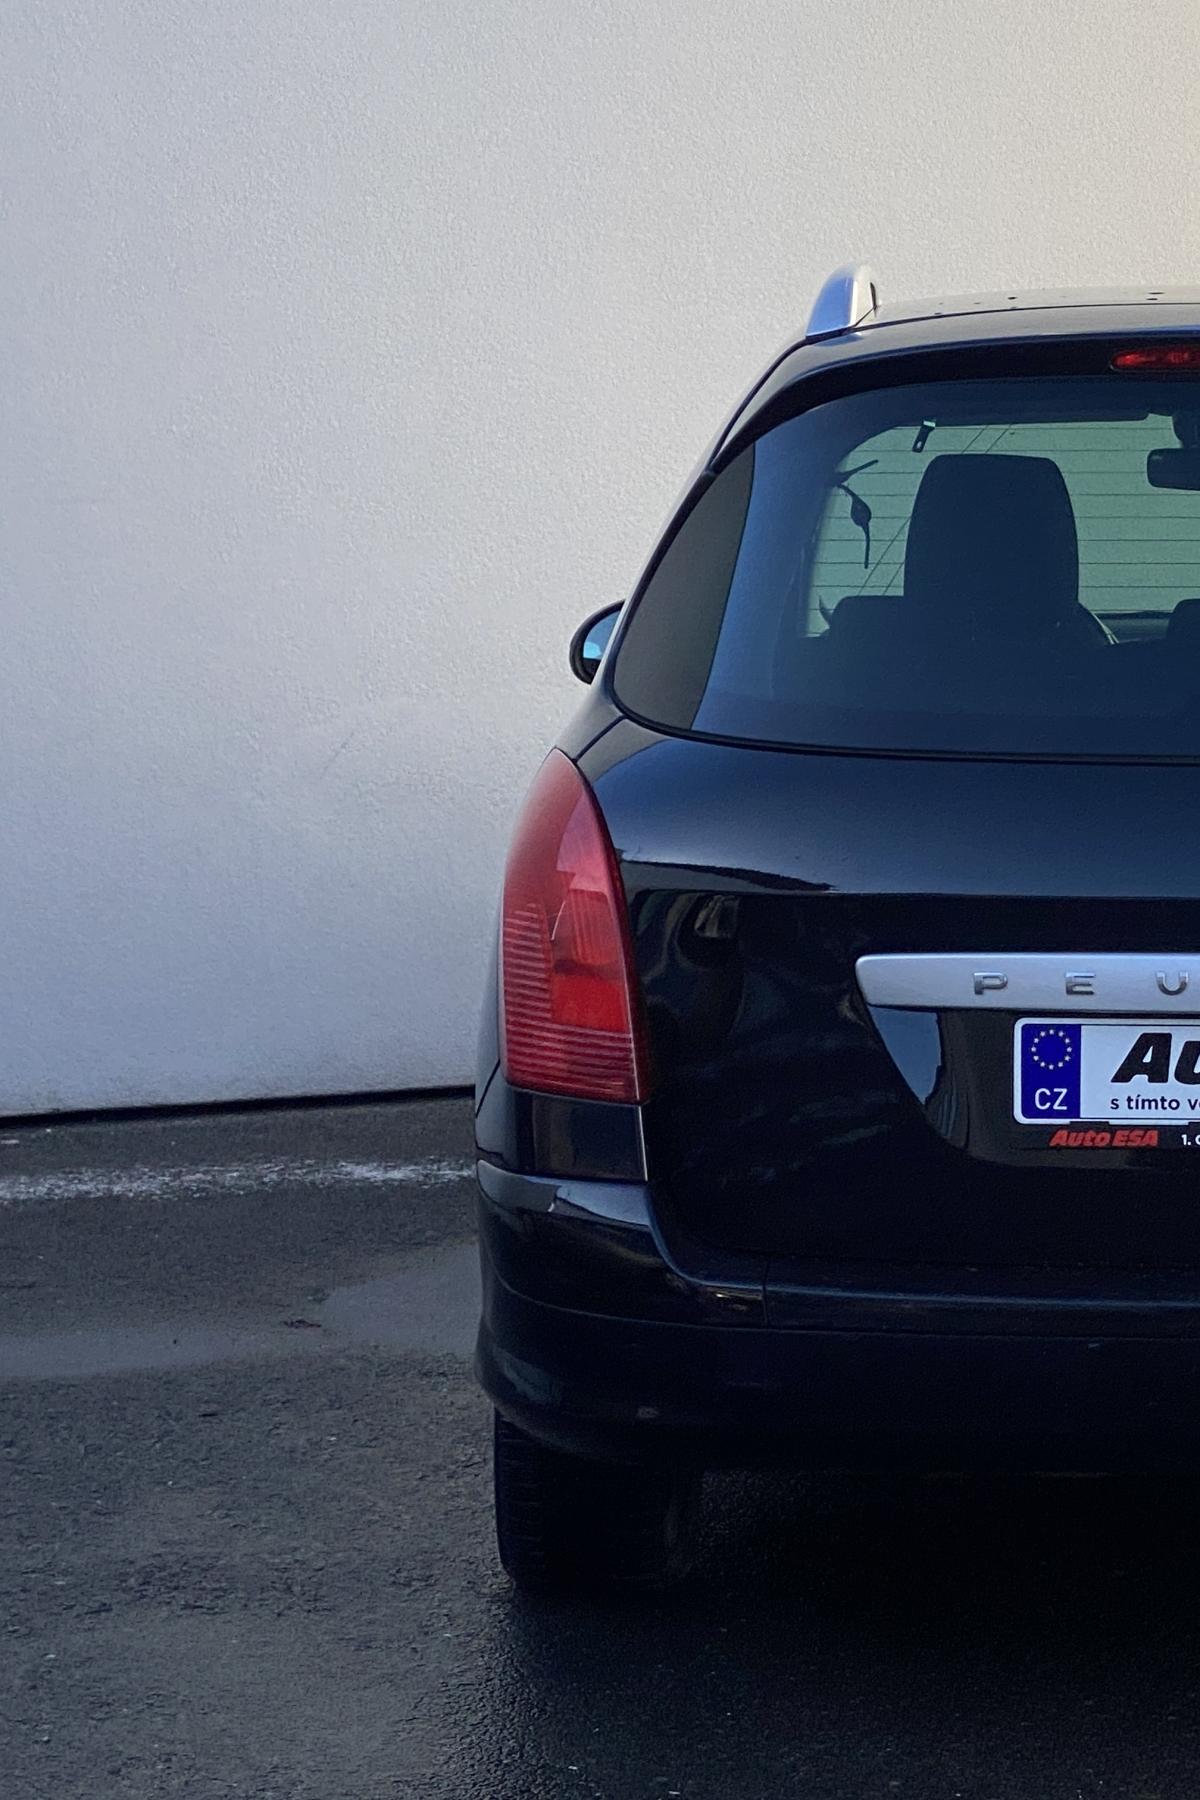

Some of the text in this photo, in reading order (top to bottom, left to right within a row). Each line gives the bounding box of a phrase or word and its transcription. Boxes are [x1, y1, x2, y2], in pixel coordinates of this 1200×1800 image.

[1034, 1087, 1068, 1111] CZ
[1110, 1099, 1120, 1112] s
[1125, 1094, 1180, 1112] tímto
[1050, 1129, 1158, 1147] Auto ESA
[1181, 1134, 1192, 1147] 1.
